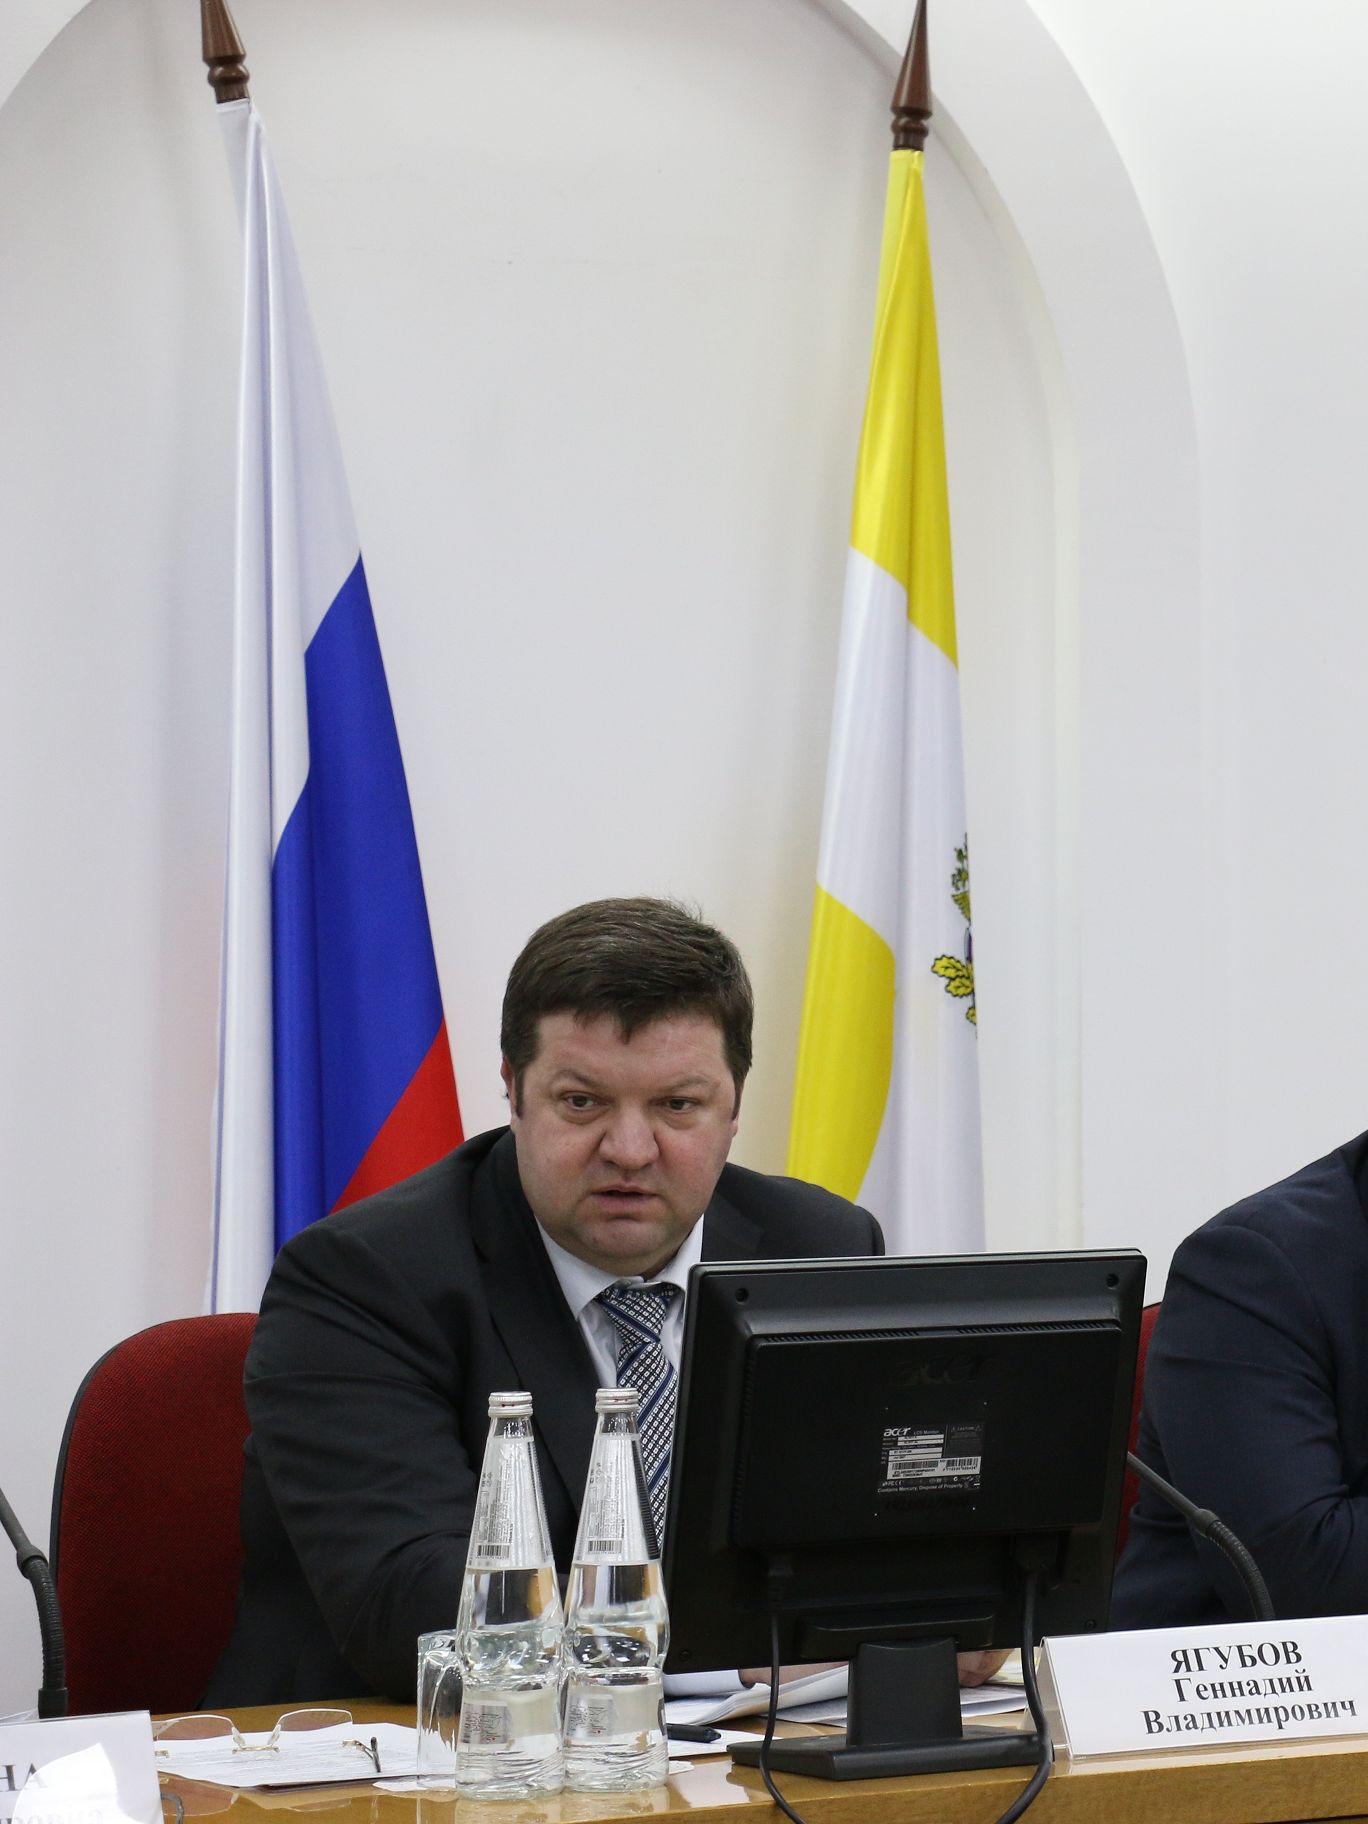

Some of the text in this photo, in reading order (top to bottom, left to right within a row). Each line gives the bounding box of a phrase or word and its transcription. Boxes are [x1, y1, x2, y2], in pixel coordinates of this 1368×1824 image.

[883, 1427, 911, 1437] acer
[1170, 1640, 1303, 1674] ЯГУБОВ
[1172, 1668, 1314, 1703] Геннадий
[1140, 1699, 1358, 1735] Владимирович
